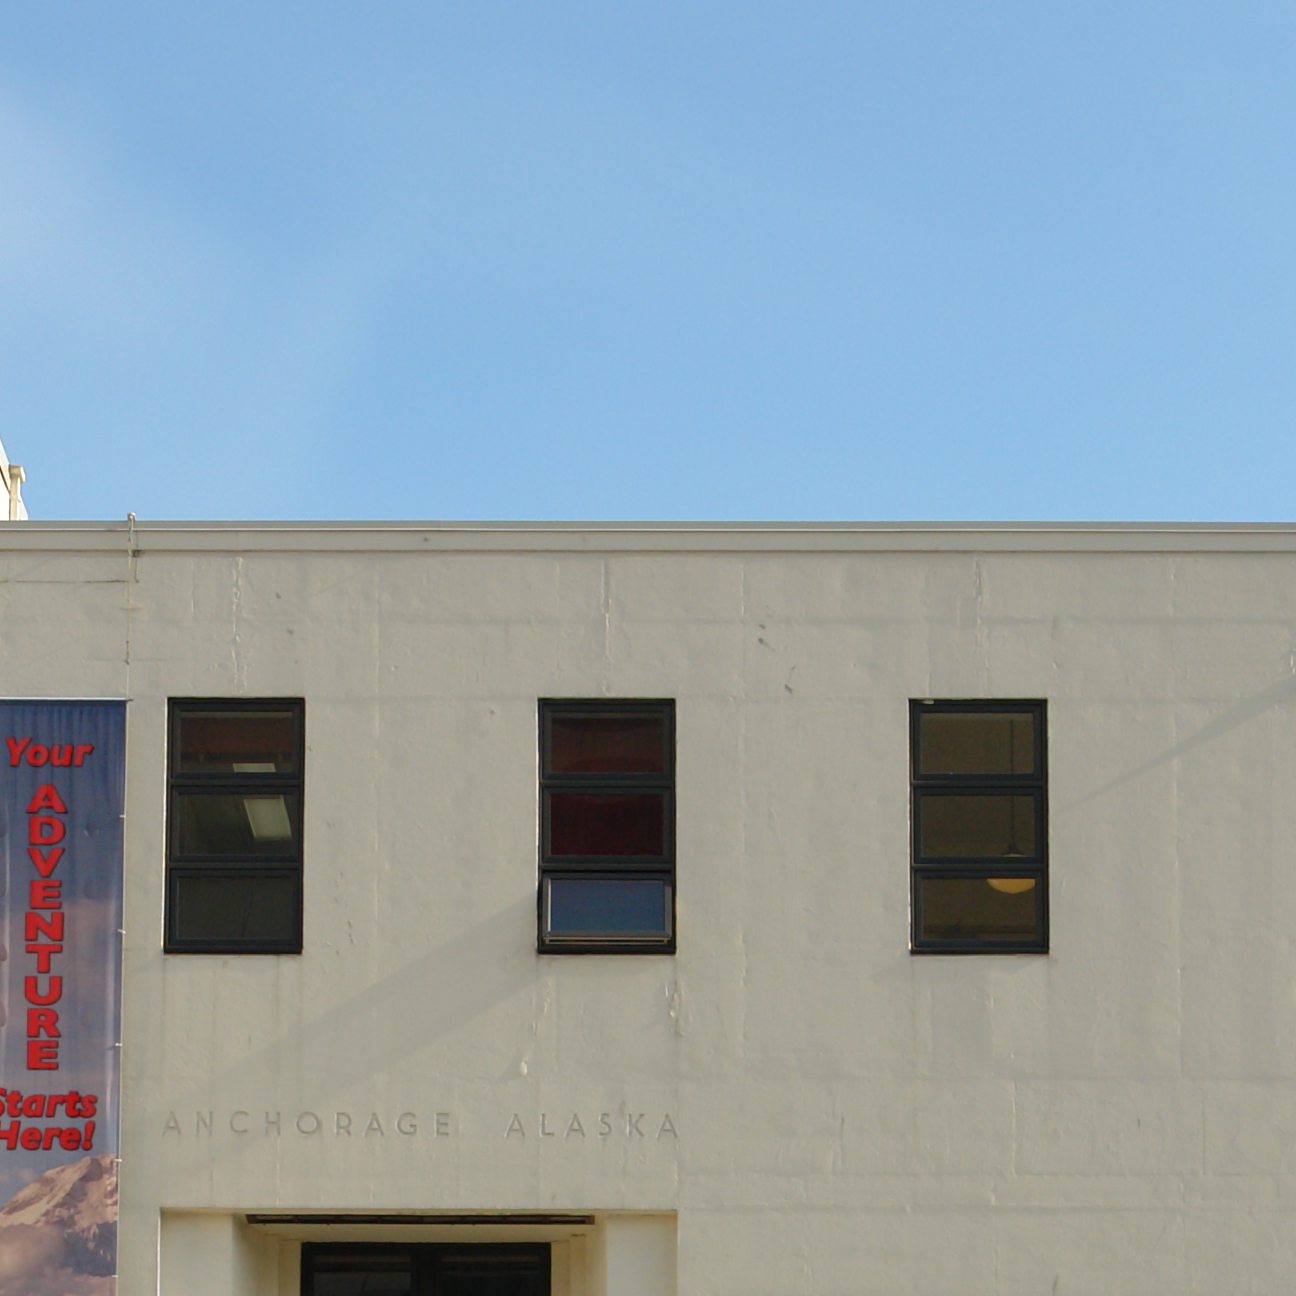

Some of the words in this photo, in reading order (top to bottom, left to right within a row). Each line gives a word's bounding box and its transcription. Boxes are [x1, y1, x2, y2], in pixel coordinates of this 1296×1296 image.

[6, 737, 93, 768] Your
[24, 784, 68, 1070] ADVENTURE
[161, 1110, 451, 1138] ANCHORAGE
[504, 1112, 679, 1139] ALASKA
